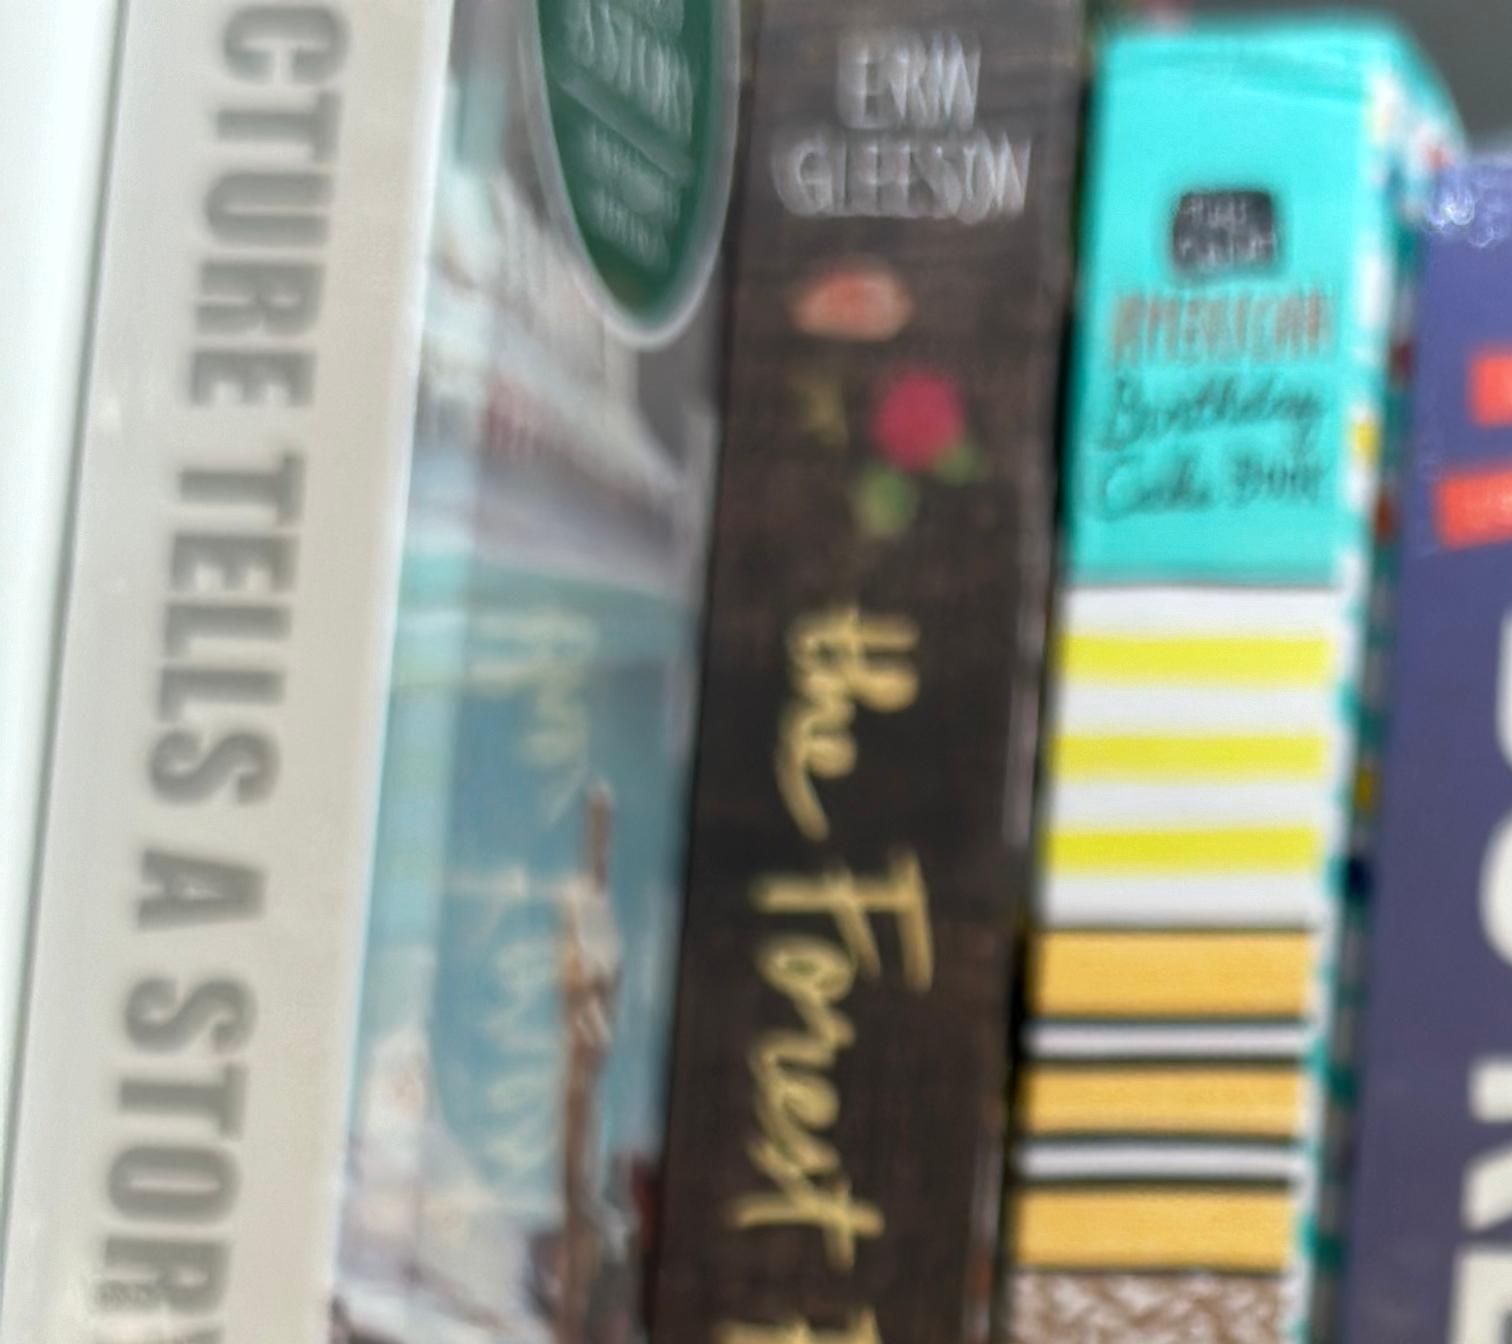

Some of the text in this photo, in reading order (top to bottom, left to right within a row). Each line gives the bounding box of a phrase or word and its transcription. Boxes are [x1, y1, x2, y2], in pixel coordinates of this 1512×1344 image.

[837, 30, 982, 130] ERIN
[770, 133, 1031, 224] GLEESON
[145, 450, 306, 807] TELLS
[776, 603, 918, 841] the
[134, 848, 269, 934] A
[730, 850, 934, 1268] Forest
